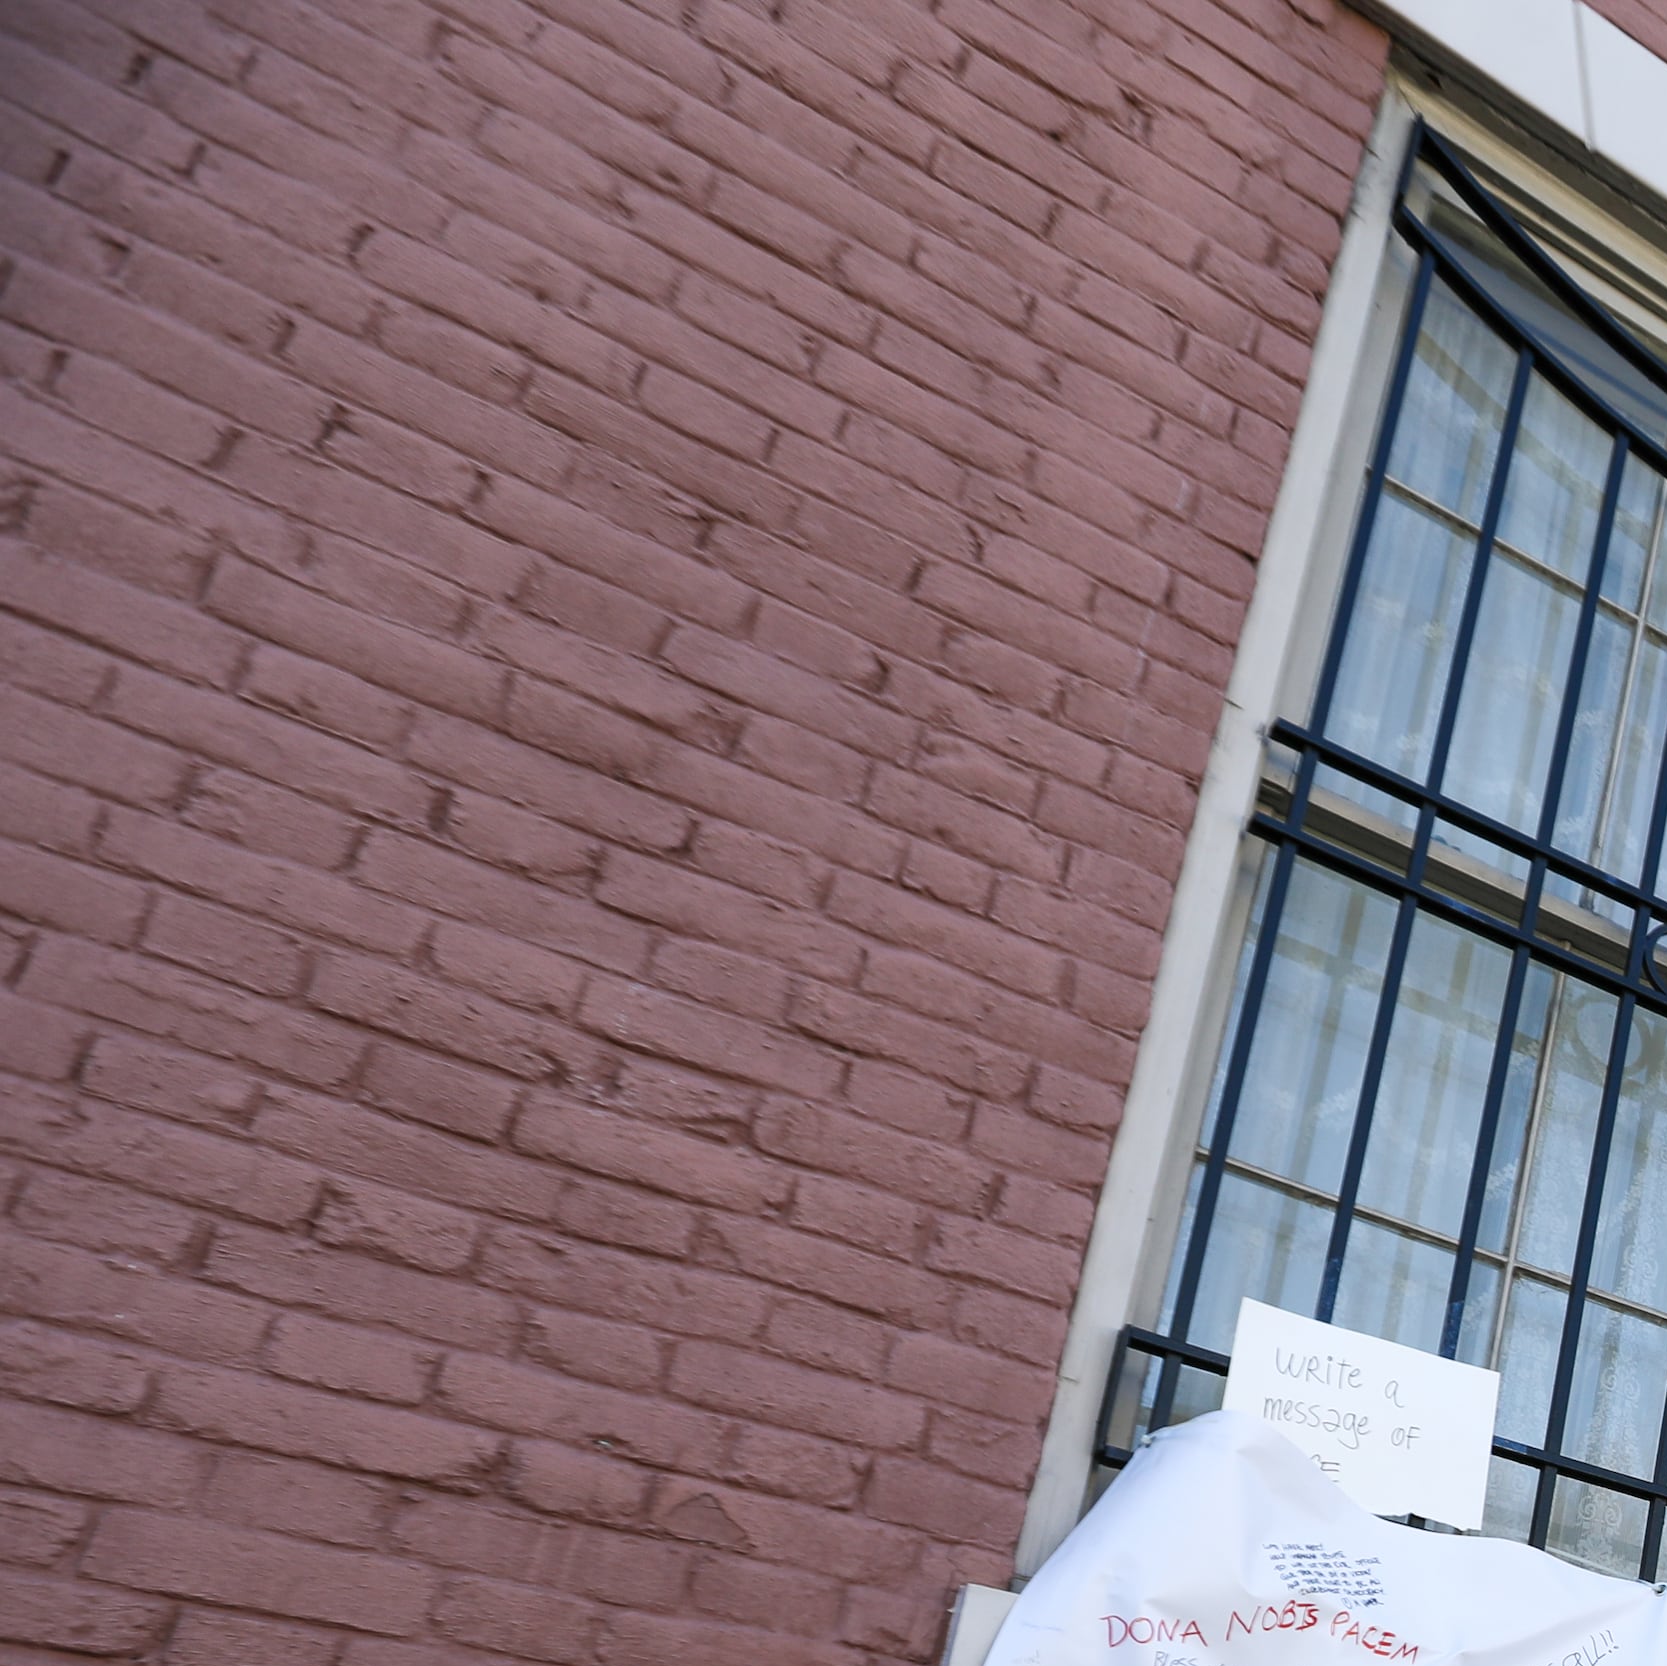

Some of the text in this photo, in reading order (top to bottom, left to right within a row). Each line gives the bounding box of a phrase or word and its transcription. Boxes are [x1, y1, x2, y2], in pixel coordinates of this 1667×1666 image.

[1385, 1380, 1405, 1408] a
[1264, 1397, 1370, 1449] message
[1099, 1600, 1419, 1664] DONA NOBIS PACEM
